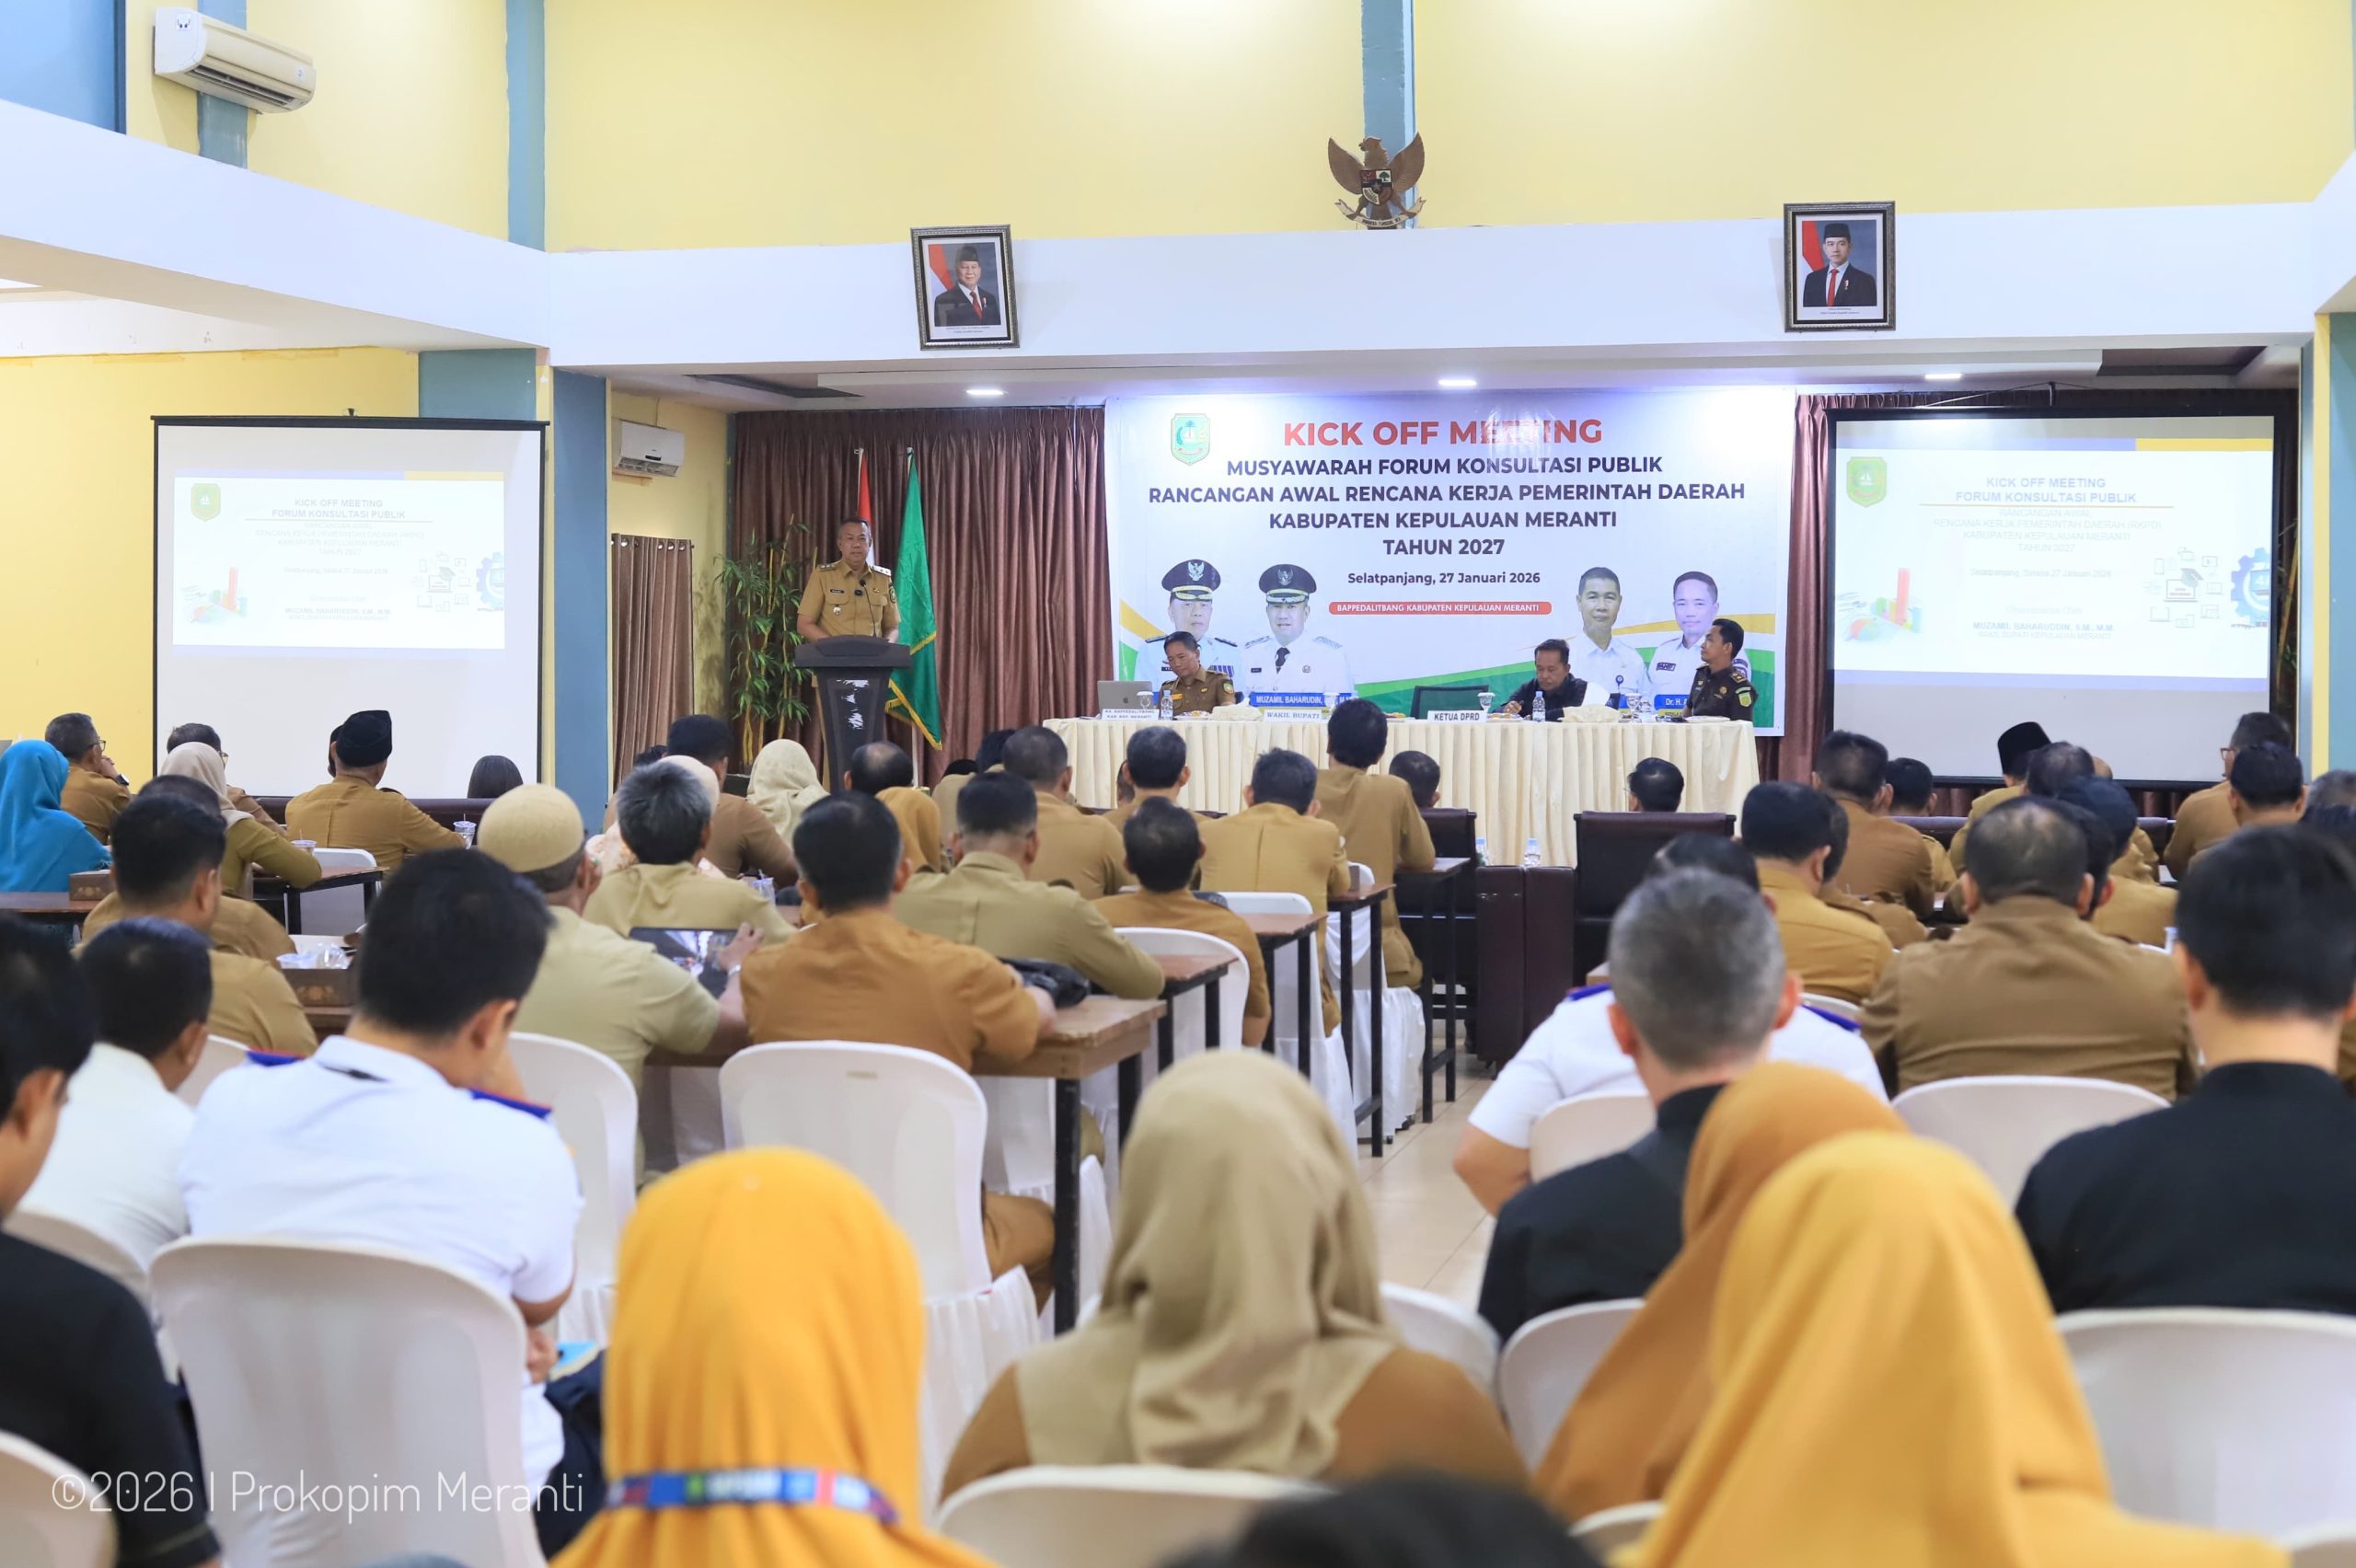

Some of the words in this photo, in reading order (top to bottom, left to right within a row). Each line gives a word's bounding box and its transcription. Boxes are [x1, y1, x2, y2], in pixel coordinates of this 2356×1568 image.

[1284, 421, 1364, 445] KICK
[1373, 421, 1438, 444] OFF
[1449, 419, 1602, 445] MEING
[1227, 459, 1372, 477] MUSYAWARAH
[1379, 458, 1450, 475] FORUM
[1458, 457, 1582, 474] KONSULTASI
[1588, 456, 1663, 473] PUBLIK
[1986, 478, 2017, 489] KICK
[2021, 478, 2046, 489] OFF
[2049, 478, 2107, 489] MEETING
[1149, 486, 1274, 503] RANCANGAN
[1279, 486, 1340, 502] AWAL
[1346, 485, 1441, 502] RENCANA
[1449, 484, 1513, 502] KERJA
[1519, 483, 1652, 501] PEMERINTAH
[1658, 483, 1745, 500] DAERAH
[1956, 491, 2002, 502] FORUM
[2005, 491, 2086, 503] KONSULTASI
[2090, 492, 2137, 503] PUBLIK
[294, 499, 318, 508] KICK
[319, 499, 339, 508] OFF
[341, 499, 384, 509] MEETING
[272, 509, 307, 518] FORUM
[309, 510, 368, 519] KONSULTASI
[371, 510, 406, 520] PUBLIK
[1270, 513, 1390, 529] KABUPATEN
[1396, 512, 1519, 529] KEPULAUAN
[1526, 511, 1617, 527] MERANTI
[1383, 539, 1453, 556] TAHUN
[1459, 538, 1505, 556] 2027
[1347, 571, 1437, 586] Selatpanjang,
[1439, 572, 1455, 584] 27
[1458, 571, 1506, 584] Januari
[1509, 572, 1541, 583] 2026
[1336, 604, 1405, 613] BAPPEDALITBANG
[1407, 604, 1452, 613] KABUPATEN
[1454, 604, 1502, 613] KEPULAUAN
[1504, 604, 1540, 613] MERANTI
[1256, 696, 1283, 704] MUZAMIL
[1665, 698, 1674, 706] Dr.
[1675, 698, 1682, 706] H.
[1434, 712, 1459, 721] KETUA
[1461, 712, 1480, 721] DPRD
